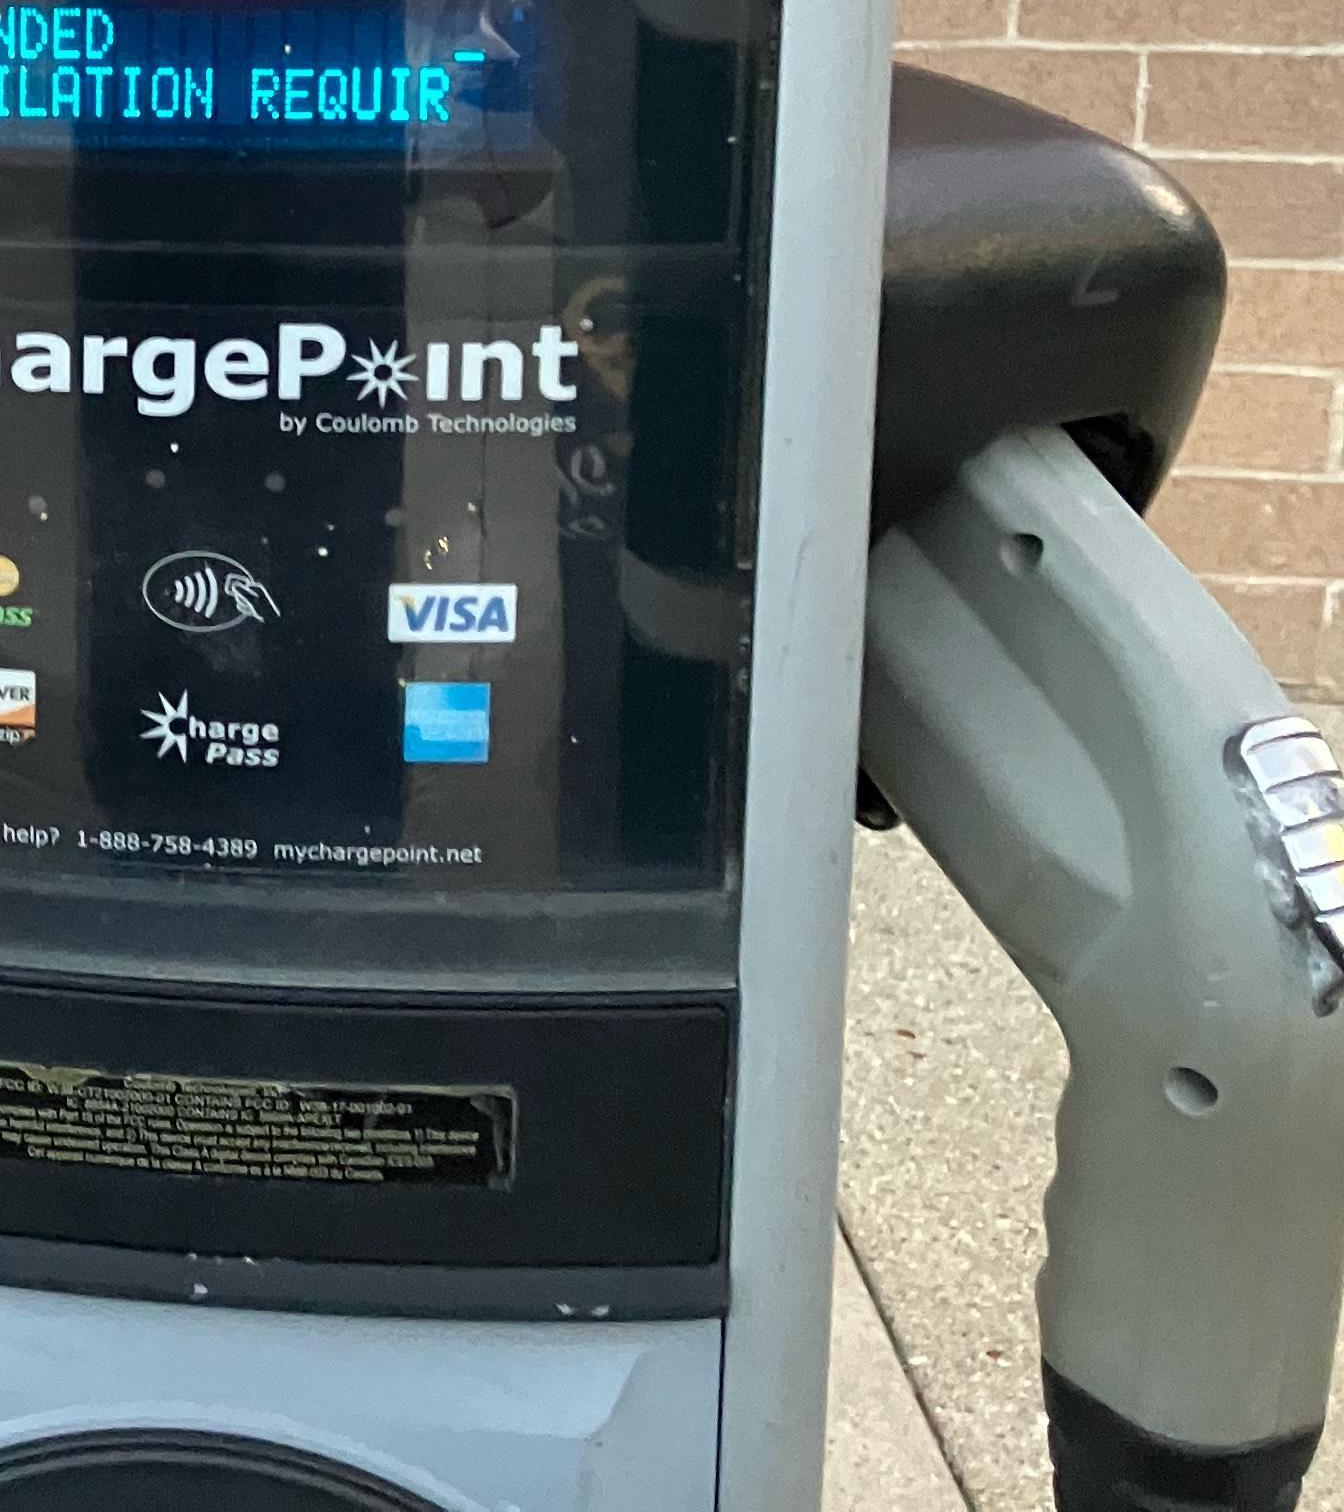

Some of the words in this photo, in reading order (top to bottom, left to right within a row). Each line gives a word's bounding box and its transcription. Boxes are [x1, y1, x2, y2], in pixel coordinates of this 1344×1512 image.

[249, 65, 452, 122] REQUIR
[279, 410, 308, 437] by
[315, 412, 420, 435] Coulomb
[426, 412, 577, 438] Technologies
[398, 595, 510, 632] VISA
[205, 741, 280, 767] Pass
[2, 821, 60, 848] help?
[76, 829, 258, 860] 1-888-758-4389
[272, 839, 483, 867] mychargepoint.net
